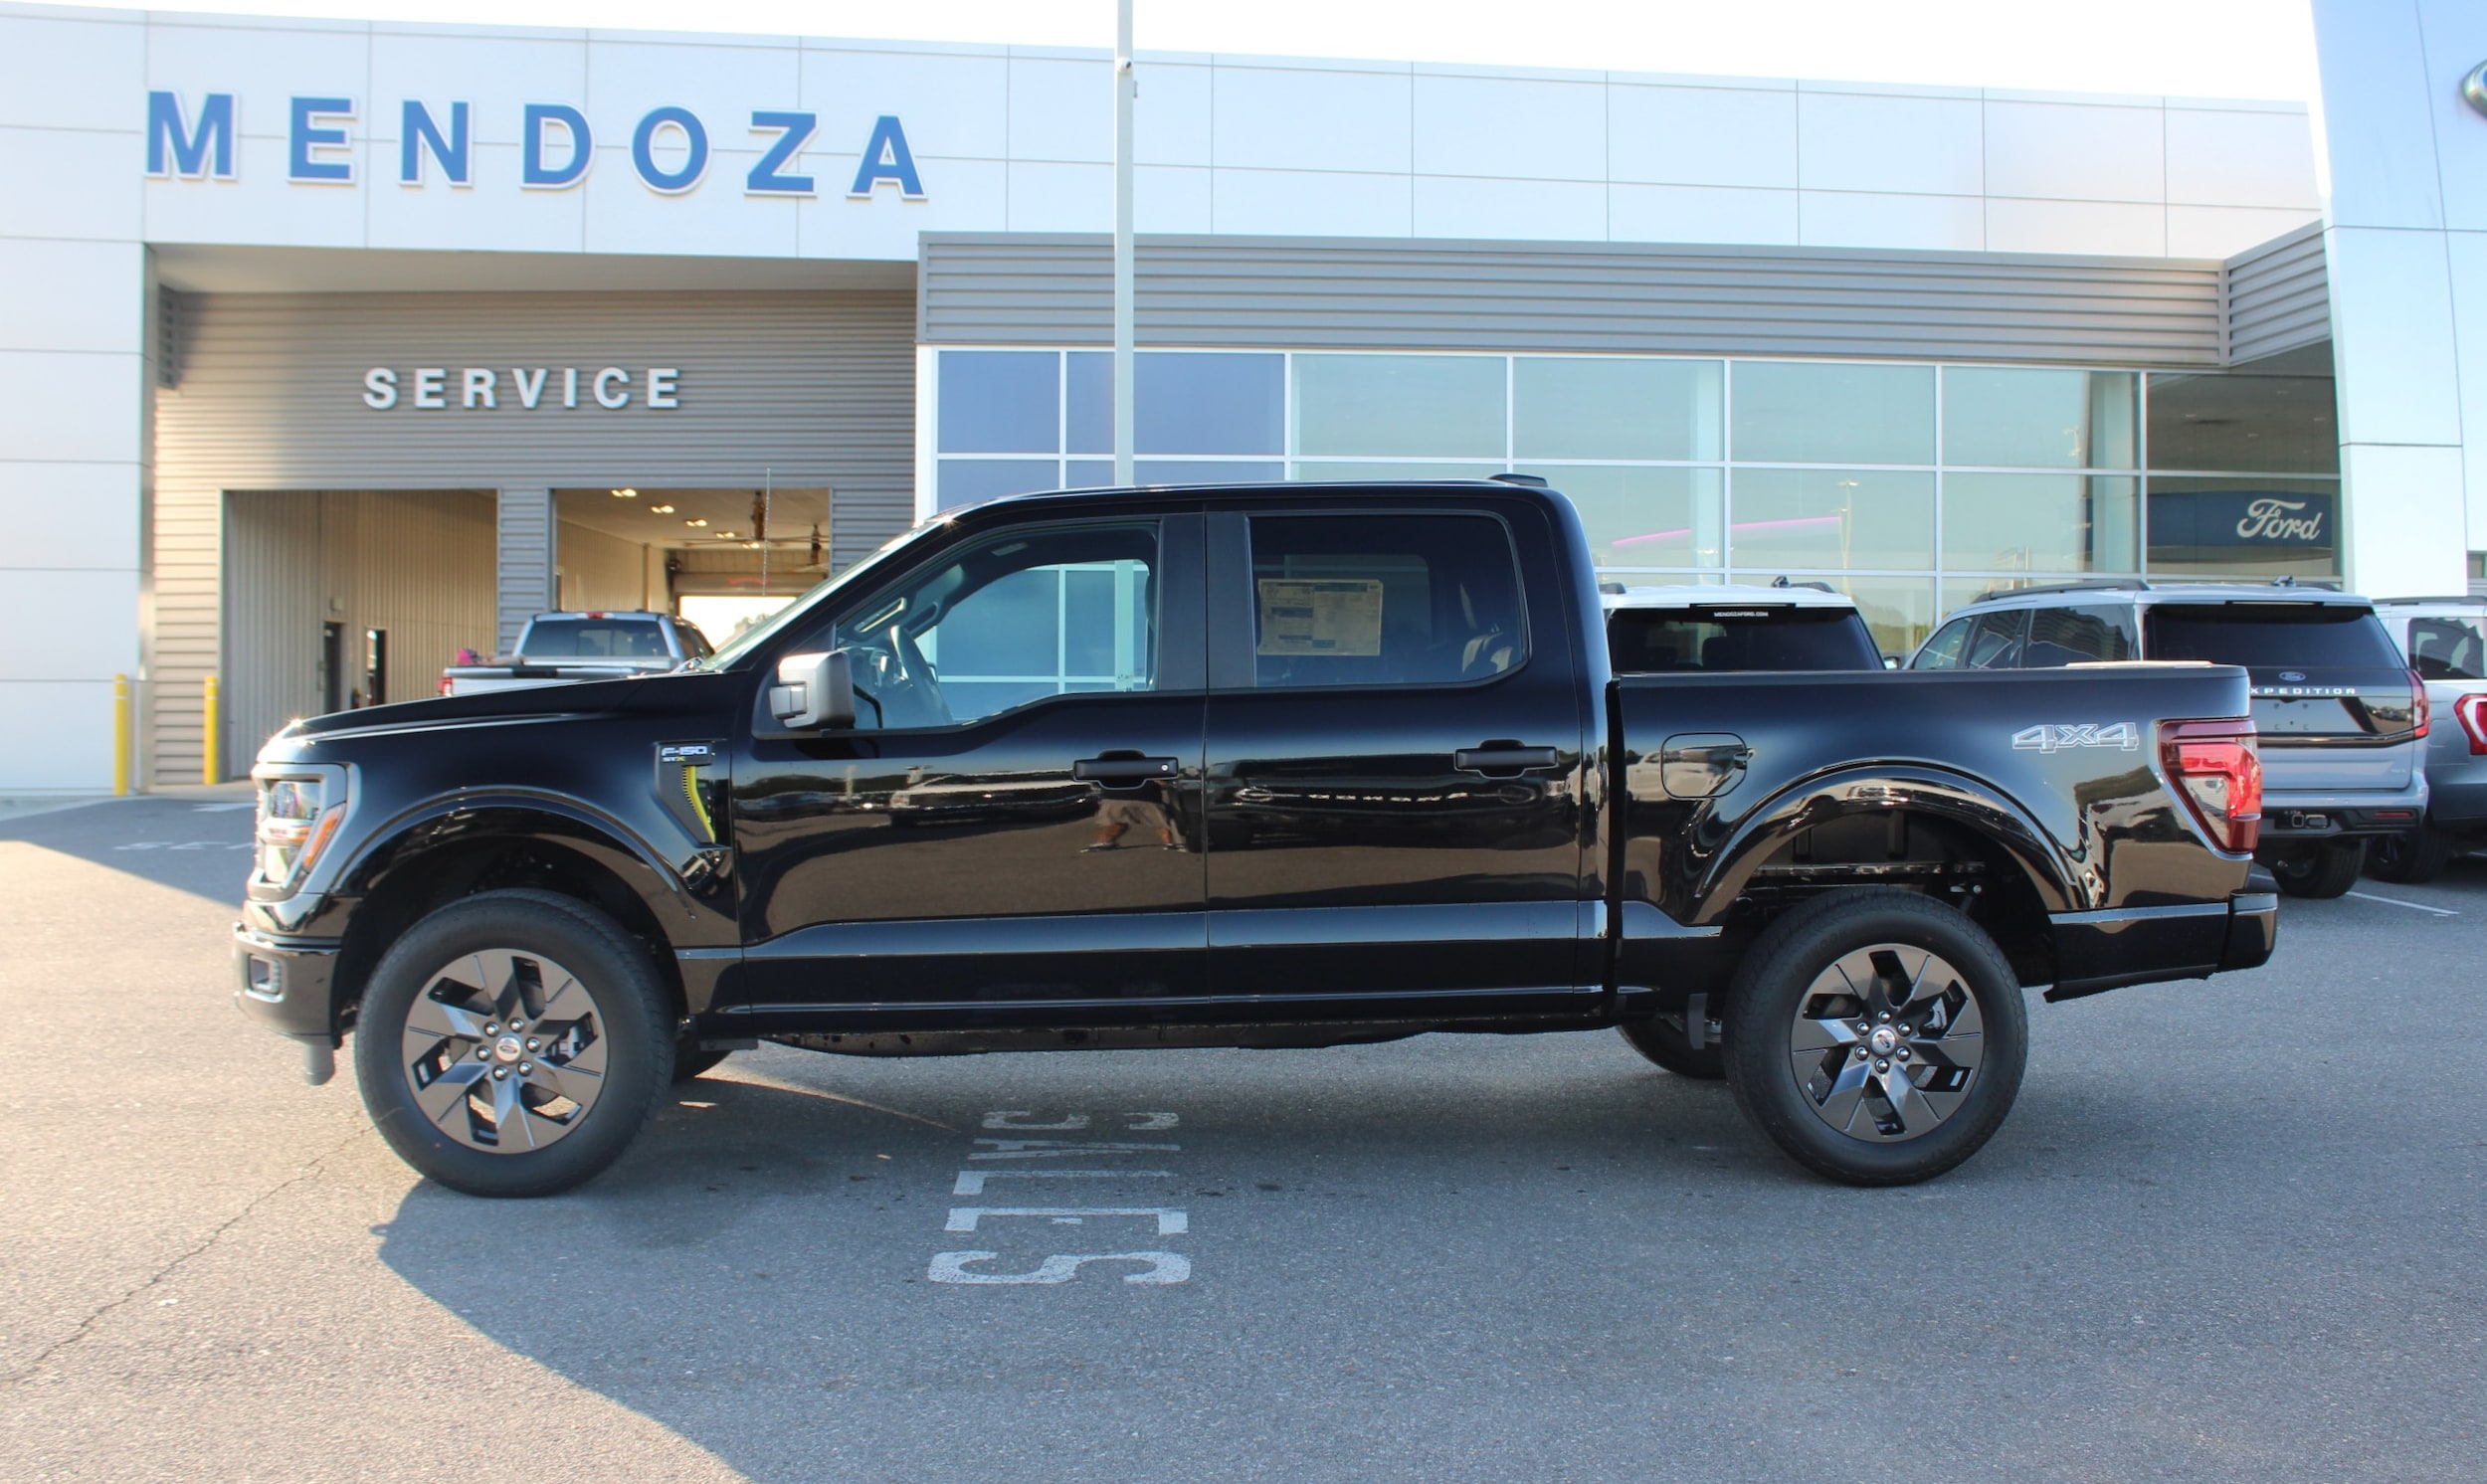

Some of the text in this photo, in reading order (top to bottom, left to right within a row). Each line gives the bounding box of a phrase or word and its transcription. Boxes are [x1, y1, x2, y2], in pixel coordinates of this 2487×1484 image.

[145, 90, 929, 201] MENDOZA
[363, 366, 681, 411] SERVICE
[2236, 498, 2323, 540] Ford
[662, 746, 707, 756] F-150
[927, 1110, 1192, 1284] SALES
